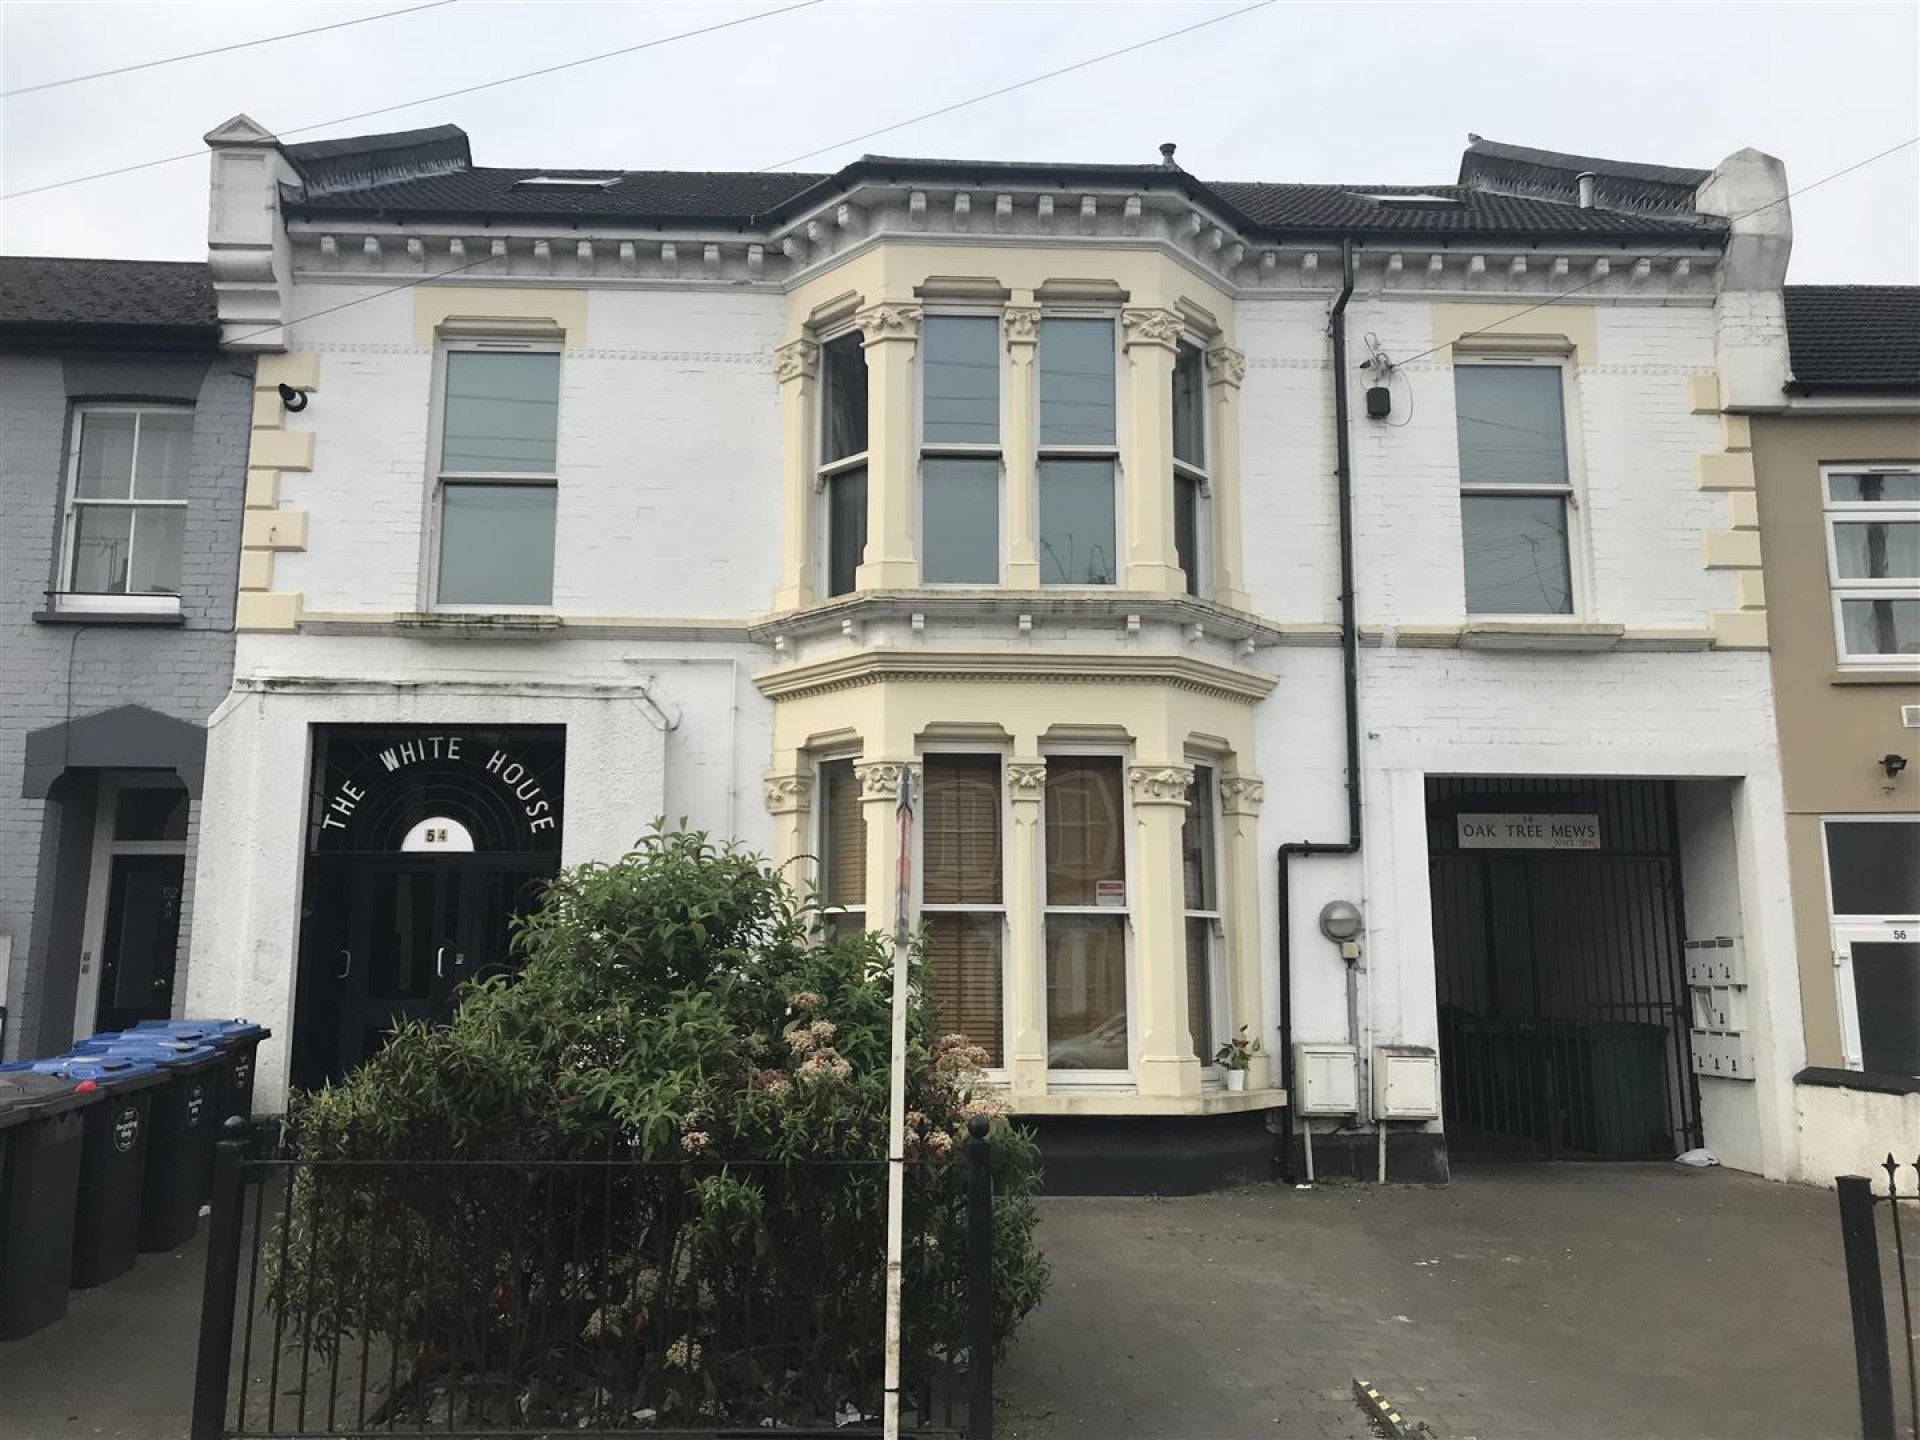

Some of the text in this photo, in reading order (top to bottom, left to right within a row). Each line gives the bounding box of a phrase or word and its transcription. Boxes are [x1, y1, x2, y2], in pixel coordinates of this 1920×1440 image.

[321, 736, 556, 834] THE WHITE HOUSE
[426, 829, 447, 842] 54
[1463, 823, 1596, 839] OAK TREE MEWS
